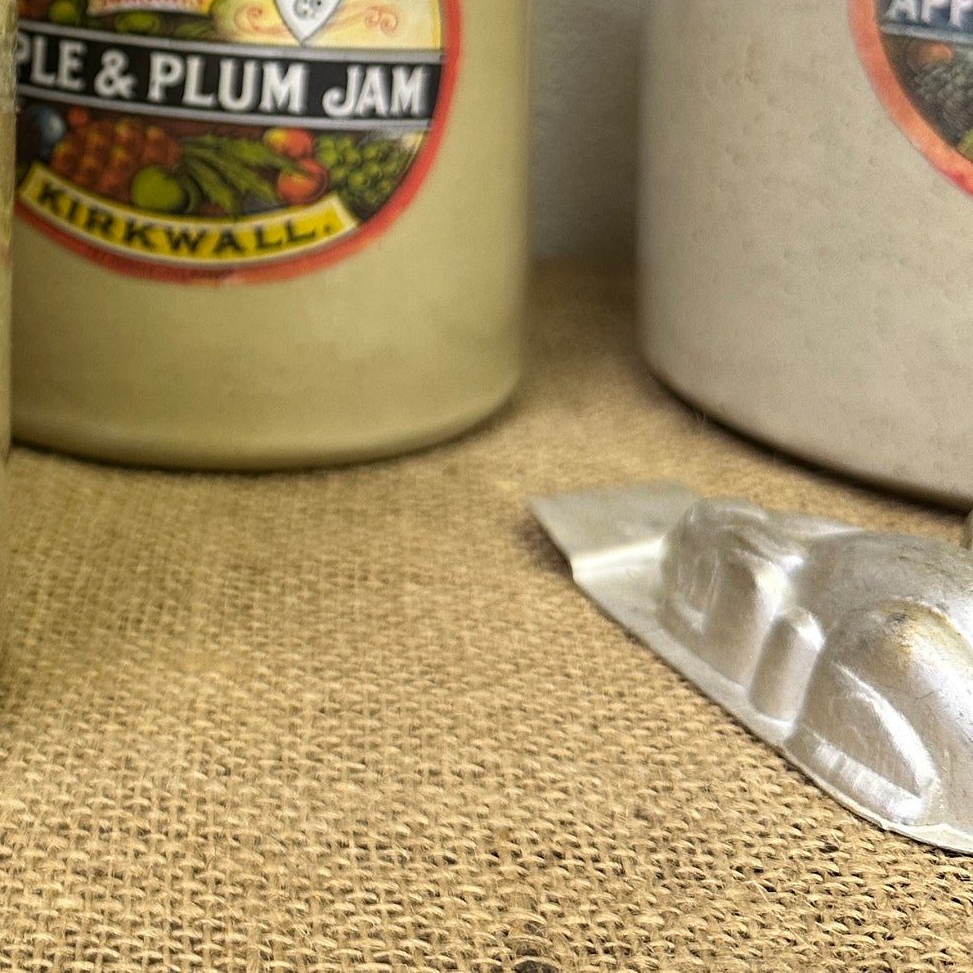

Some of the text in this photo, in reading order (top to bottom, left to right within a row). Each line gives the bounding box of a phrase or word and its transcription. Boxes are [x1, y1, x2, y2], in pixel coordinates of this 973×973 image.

[94, 49, 139, 99] &
[148, 52, 308, 114] PLUM
[322, 64, 426, 119] JAM
